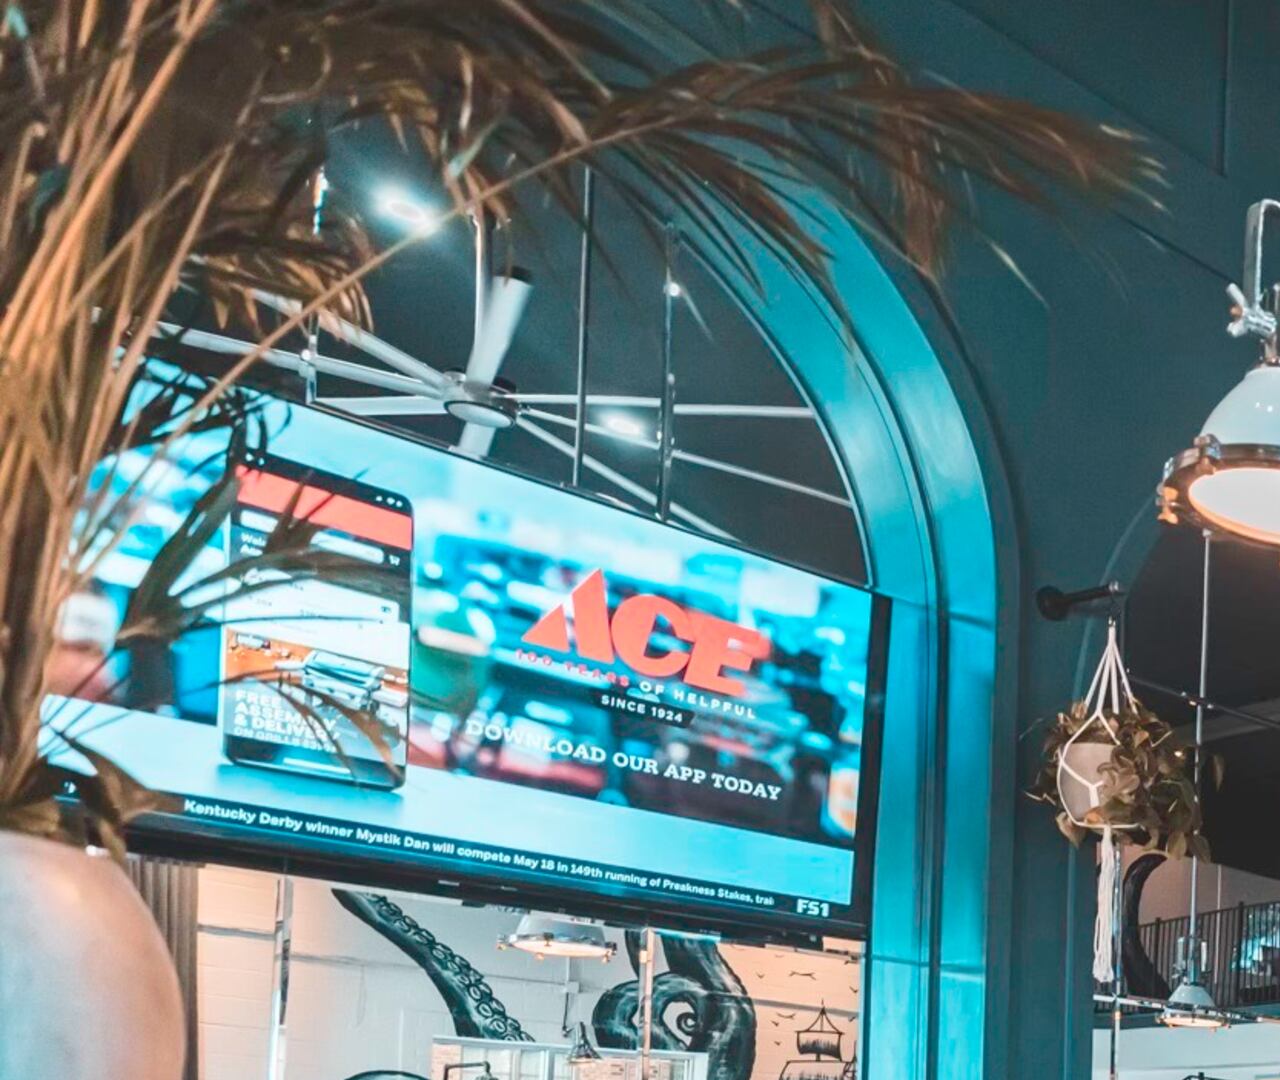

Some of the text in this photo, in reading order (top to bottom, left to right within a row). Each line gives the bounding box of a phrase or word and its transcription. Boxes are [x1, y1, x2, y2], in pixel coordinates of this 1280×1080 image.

[521, 568, 772, 697] ACE
[235, 689, 282, 708] FREE
[567, 661, 630, 688] YEARS
[640, 680, 664, 695] OF
[674, 689, 757, 719] HELPFUL
[601, 695, 684, 723] SINCE 1924
[234, 702, 336, 731] ASSEMY
[466, 719, 782, 800] DOWNLOAD OUR APP TODAY
[183, 798, 256, 824] Kentucky
[259, 809, 302, 833] Derby
[306, 821, 353, 838] winner
[356, 828, 401, 848] Mystik
[404, 836, 429, 851] Dan
[432, 839, 455, 855] will
[457, 845, 511, 865] compete
[514, 854, 538, 872] May
[541, 858, 554, 872] 18
[557, 861, 568, 874] in
[570, 863, 602, 879] 149th
[605, 869, 648, 888] running
[650, 875, 661, 888] of
[663, 878, 715, 898] Preakness
[718, 888, 754, 906] Stakes,
[797, 898, 829, 918] FS1
